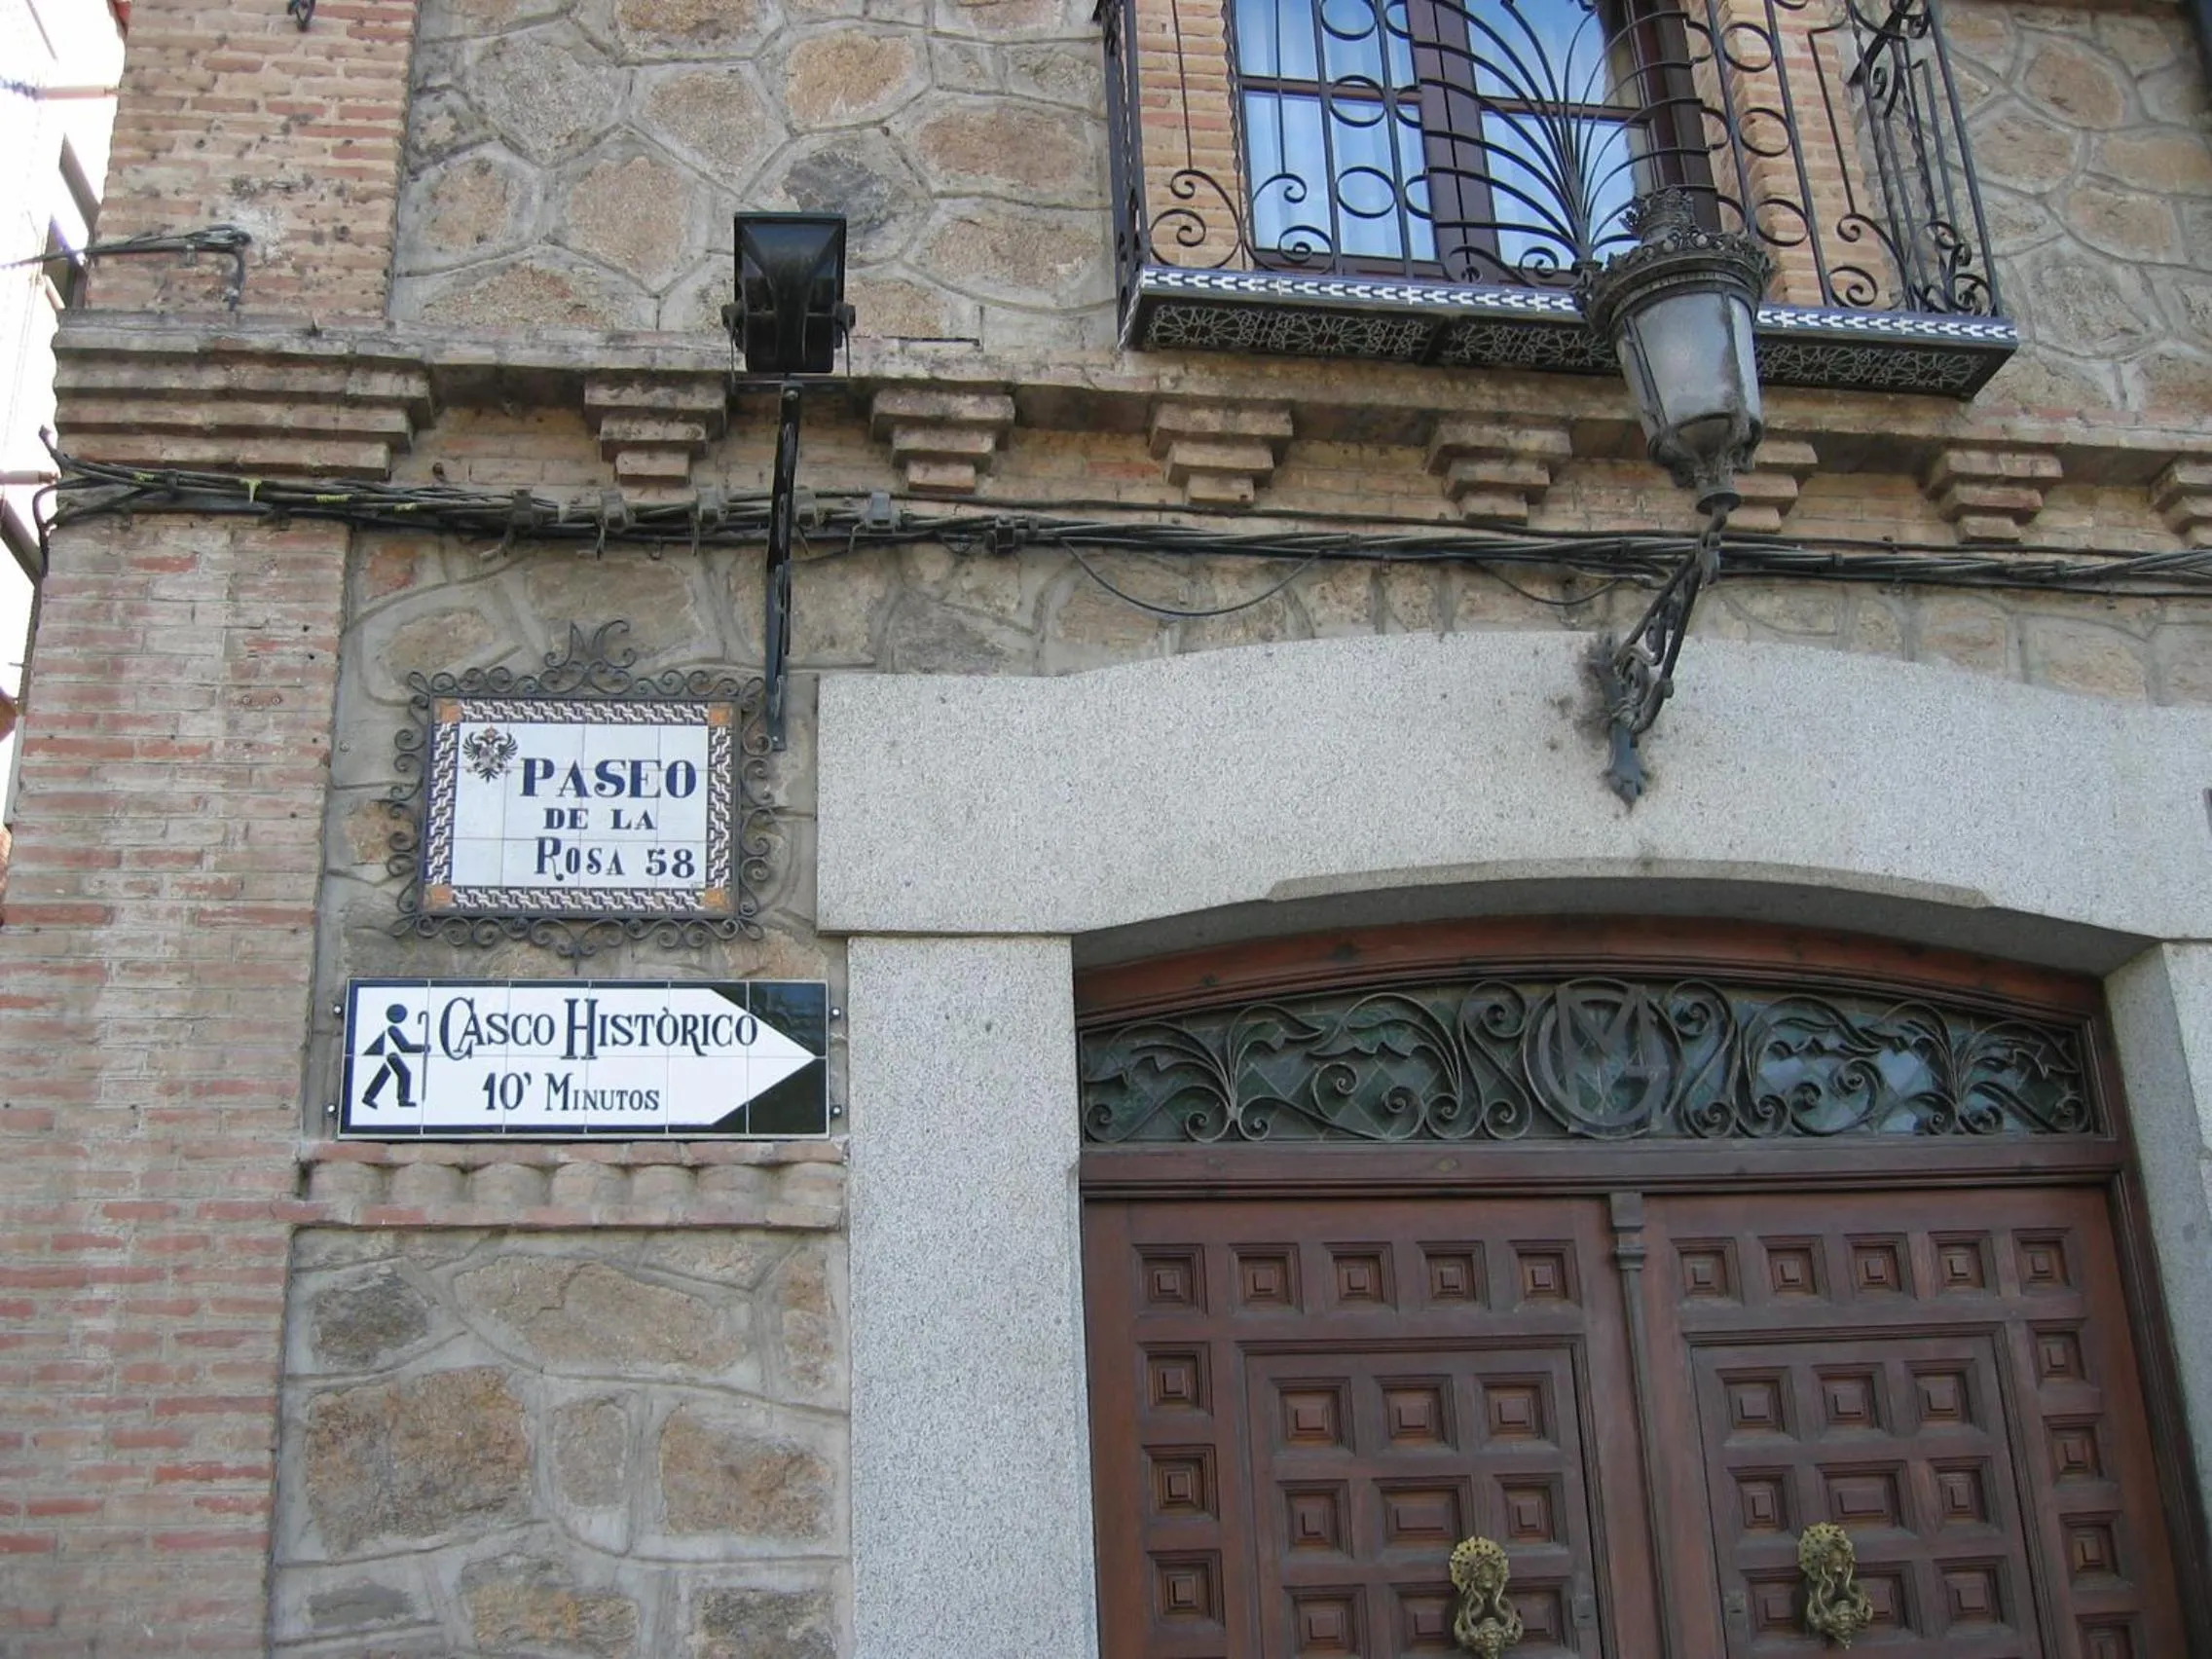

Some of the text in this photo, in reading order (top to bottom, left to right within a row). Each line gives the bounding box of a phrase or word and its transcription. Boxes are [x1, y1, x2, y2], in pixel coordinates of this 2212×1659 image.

[519, 757, 697, 799] PASEO
[543, 807, 657, 830] DE LA
[534, 836, 695, 881] ROSA 58
[439, 997, 555, 1060] CASCO
[544, 1073, 661, 1112] MINUTOS
